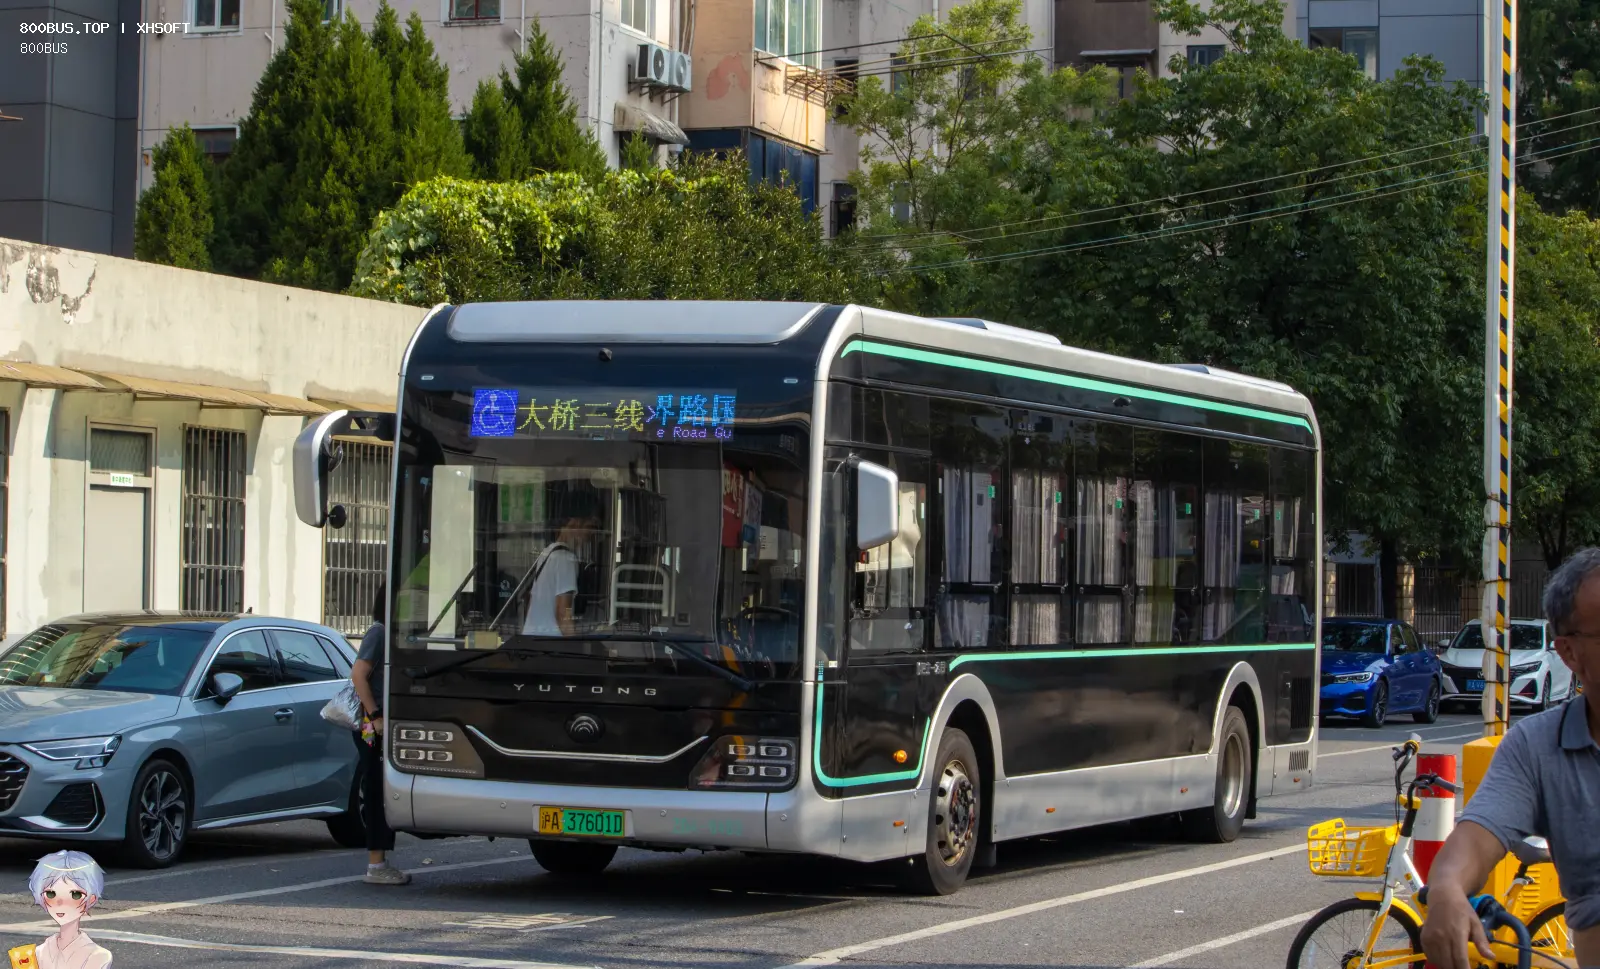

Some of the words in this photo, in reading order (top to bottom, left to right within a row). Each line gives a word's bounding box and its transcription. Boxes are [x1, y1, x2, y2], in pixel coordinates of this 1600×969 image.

[516, 398, 644, 432] 大桥三线
[673, 426, 707, 438] Road
[714, 427, 732, 439] Gu
[513, 683, 657, 696] YUTONG
